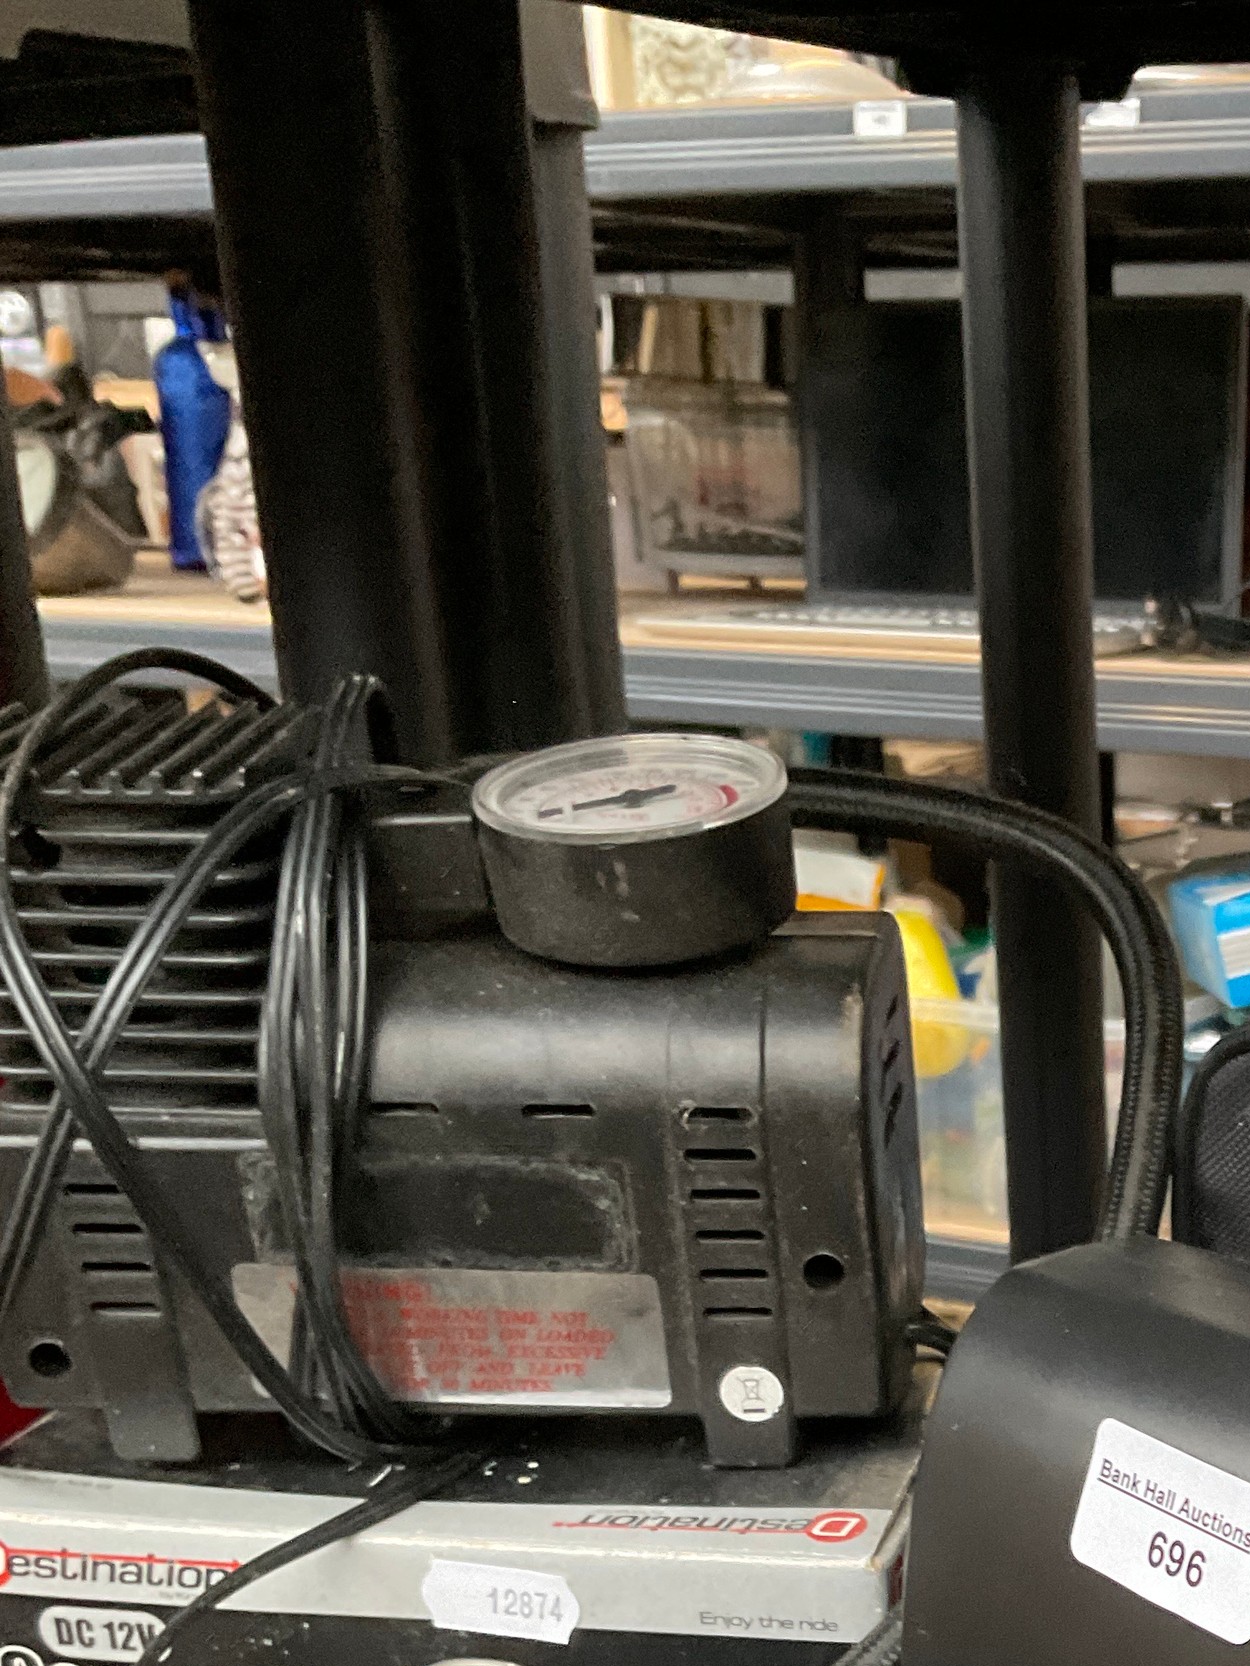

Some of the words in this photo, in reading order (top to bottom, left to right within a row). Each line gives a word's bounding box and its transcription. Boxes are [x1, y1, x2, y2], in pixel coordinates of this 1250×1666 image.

[1100, 1458, 1140, 1493] Bank
[1143, 1479, 1177, 1511] Hall
[581, 1511, 864, 1540] Destination
[0, 1545, 230, 1591] estination
[1148, 1531, 1206, 1587] 696
[487, 1587, 563, 1622] 12874
[700, 1612, 752, 1629] Enjoy
[759, 1616, 793, 1629] the
[800, 1618, 838, 1632] ride
[54, 1617, 95, 1648] DC
[103, 1621, 156, 1652] 12V
